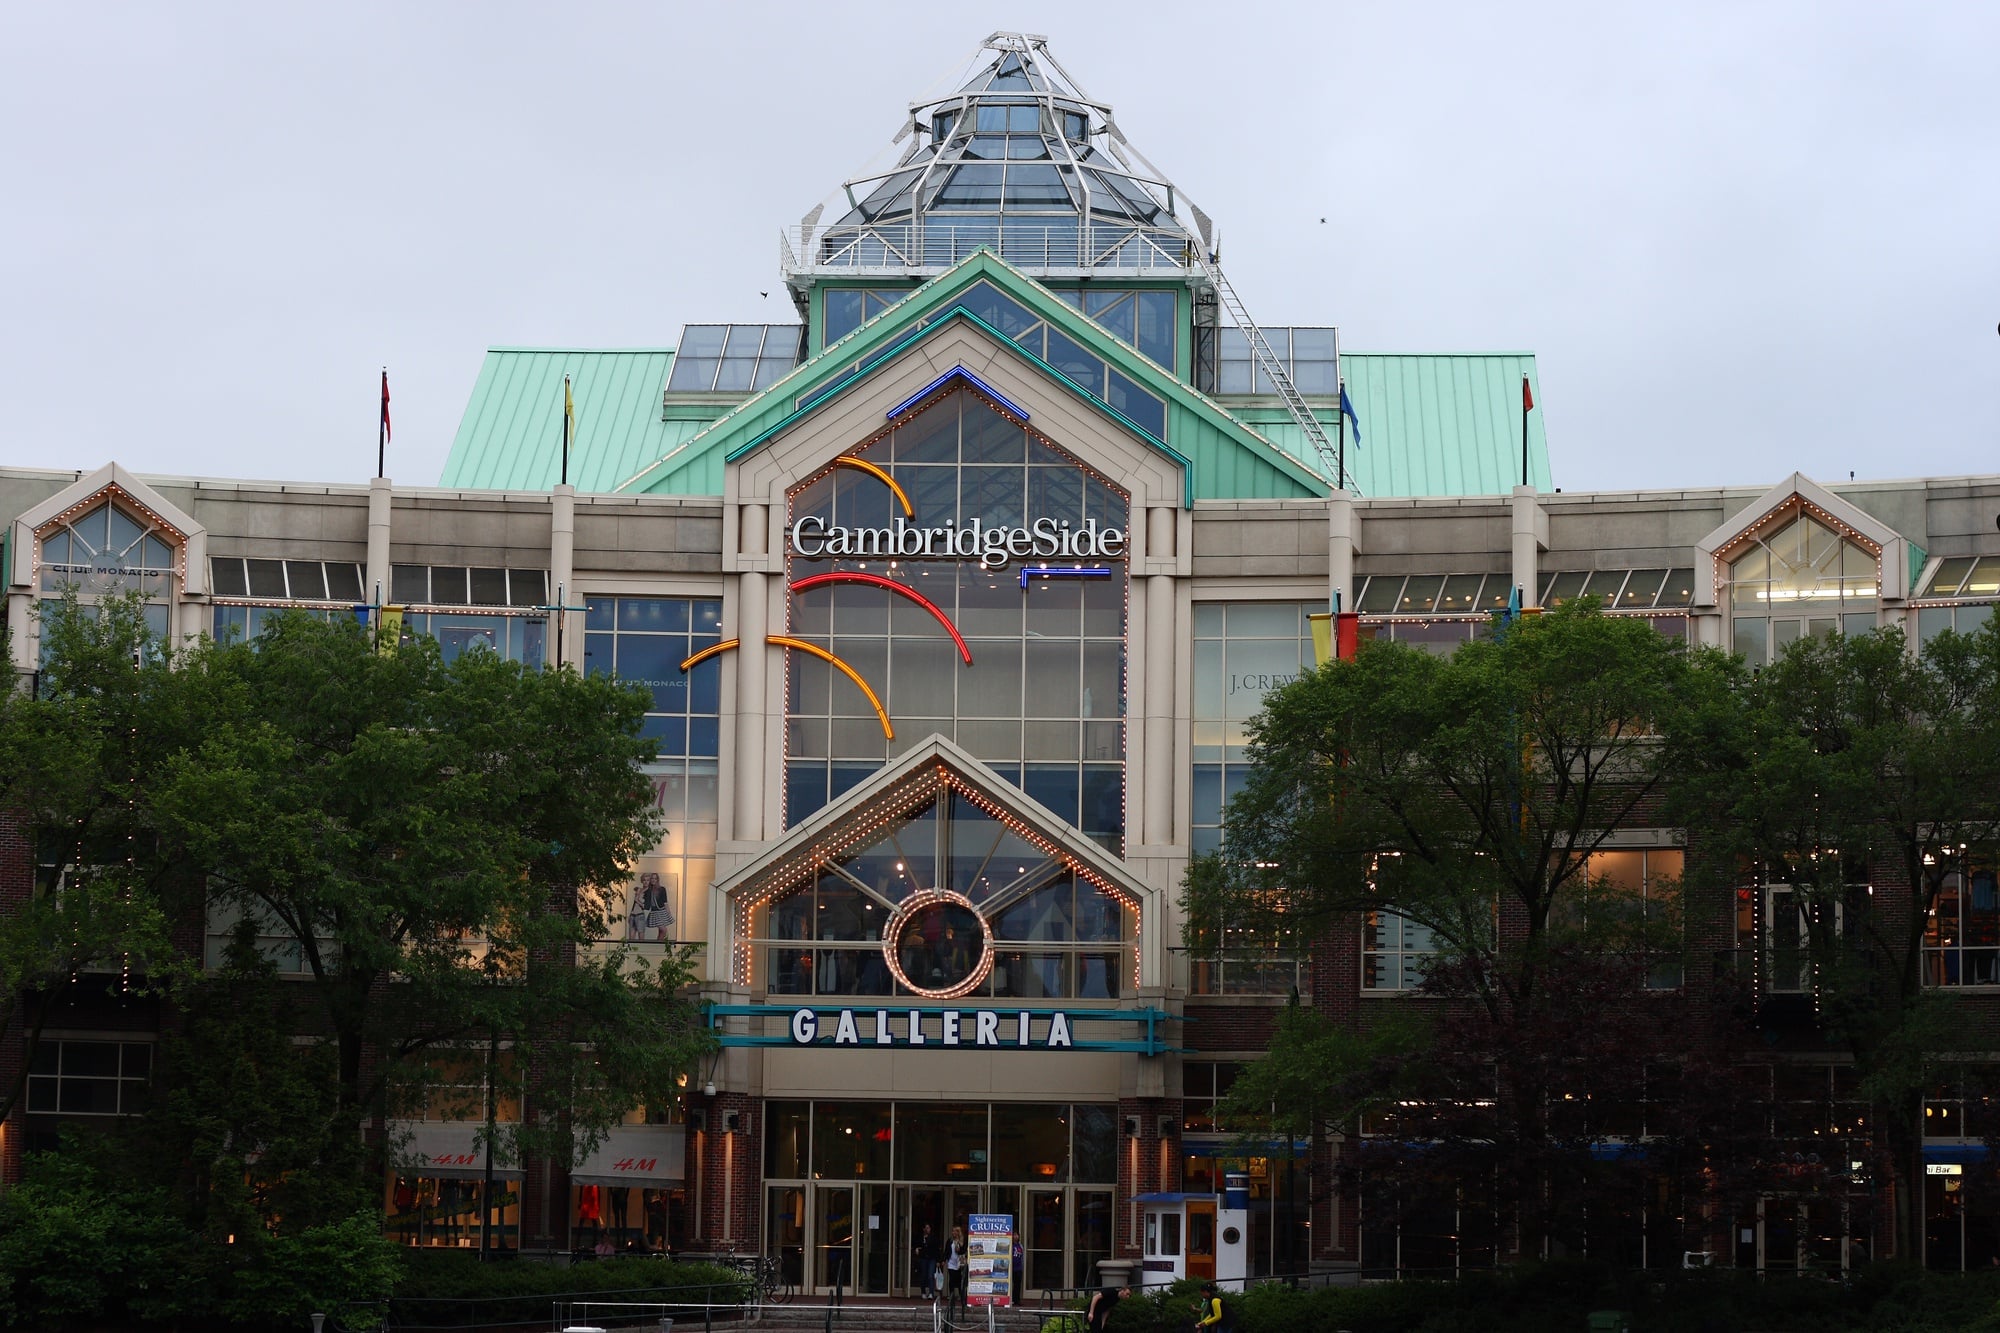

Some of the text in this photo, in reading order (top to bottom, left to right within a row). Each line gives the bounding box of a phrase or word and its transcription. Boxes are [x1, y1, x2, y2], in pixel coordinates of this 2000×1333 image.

[792, 515, 1123, 566] CambridgeSide
[53, 565, 159, 577] CLUB MONACO
[792, 1008, 1073, 1047] GALLERIA
[613, 1158, 657, 1171] H&M
[970, 1223, 1011, 1232] CRUISES
